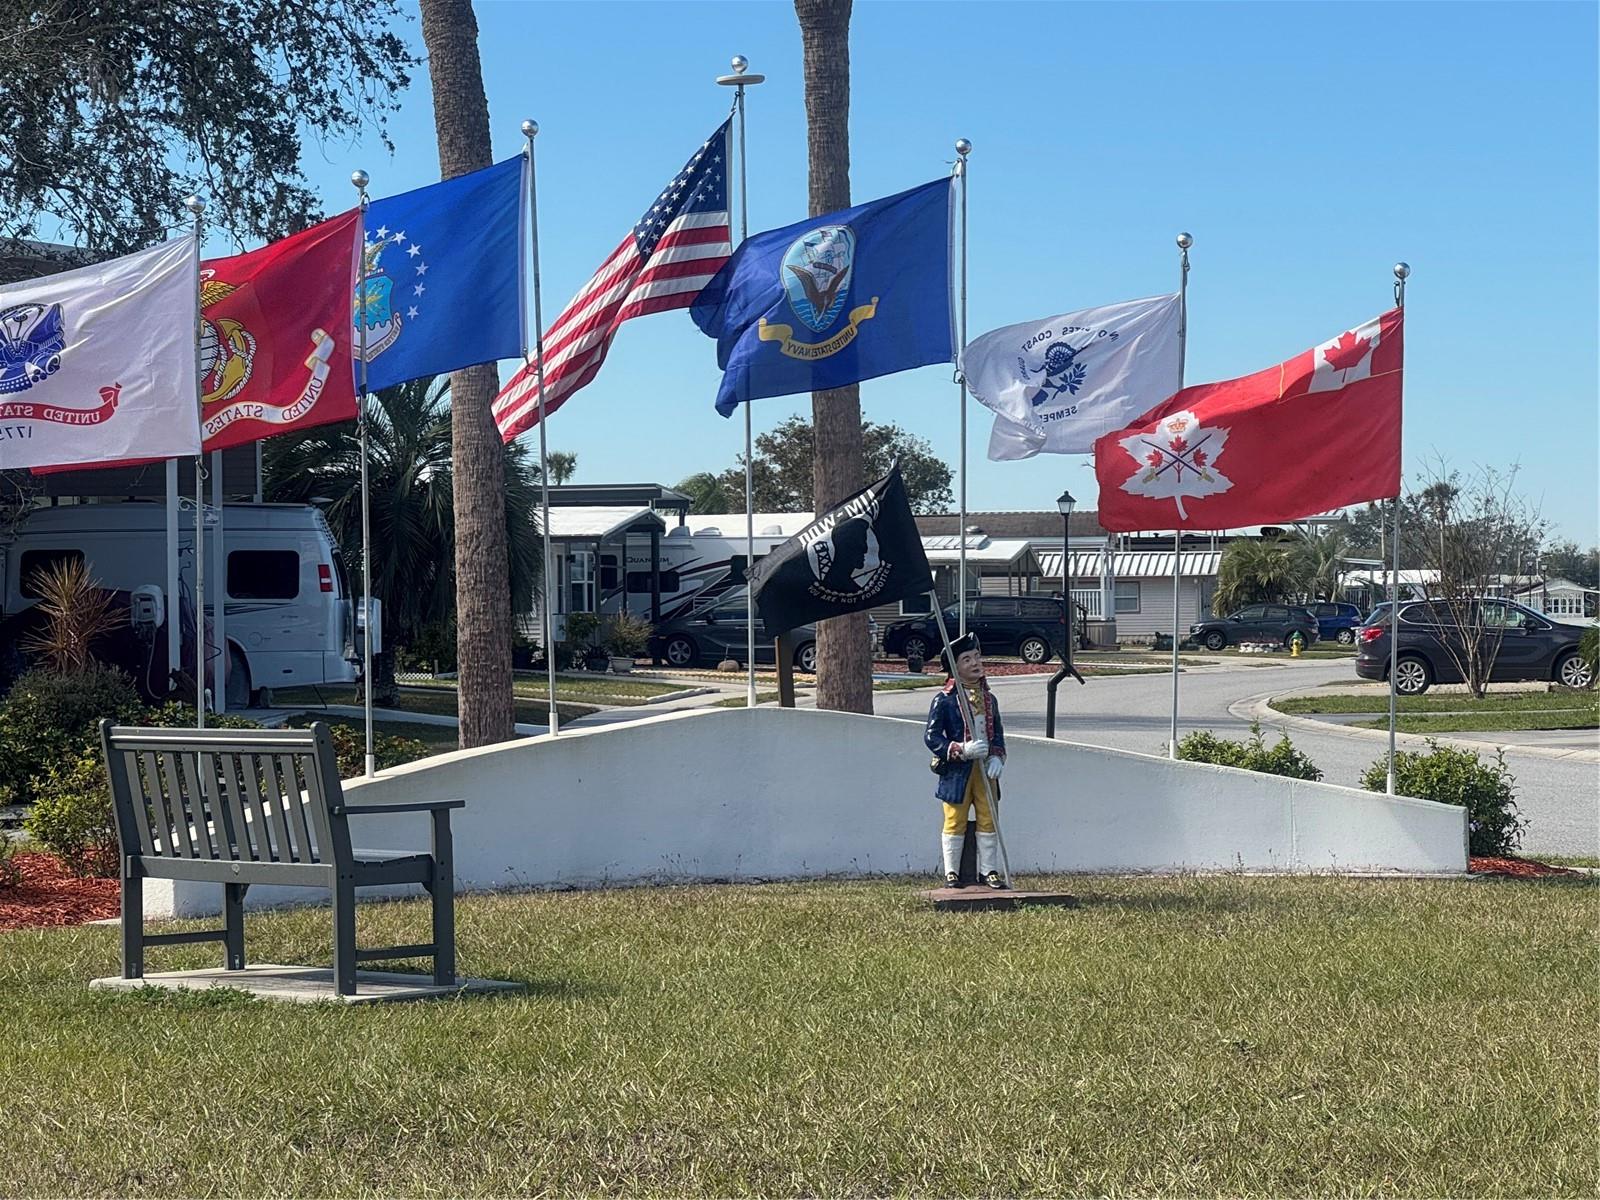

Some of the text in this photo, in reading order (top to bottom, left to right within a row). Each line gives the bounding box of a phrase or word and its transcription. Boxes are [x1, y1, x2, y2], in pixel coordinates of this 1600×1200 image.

[807, 585, 820, 597] YOU
[819, 594, 838, 603] ARE
[861, 562, 893, 601] FORGOTTEN
